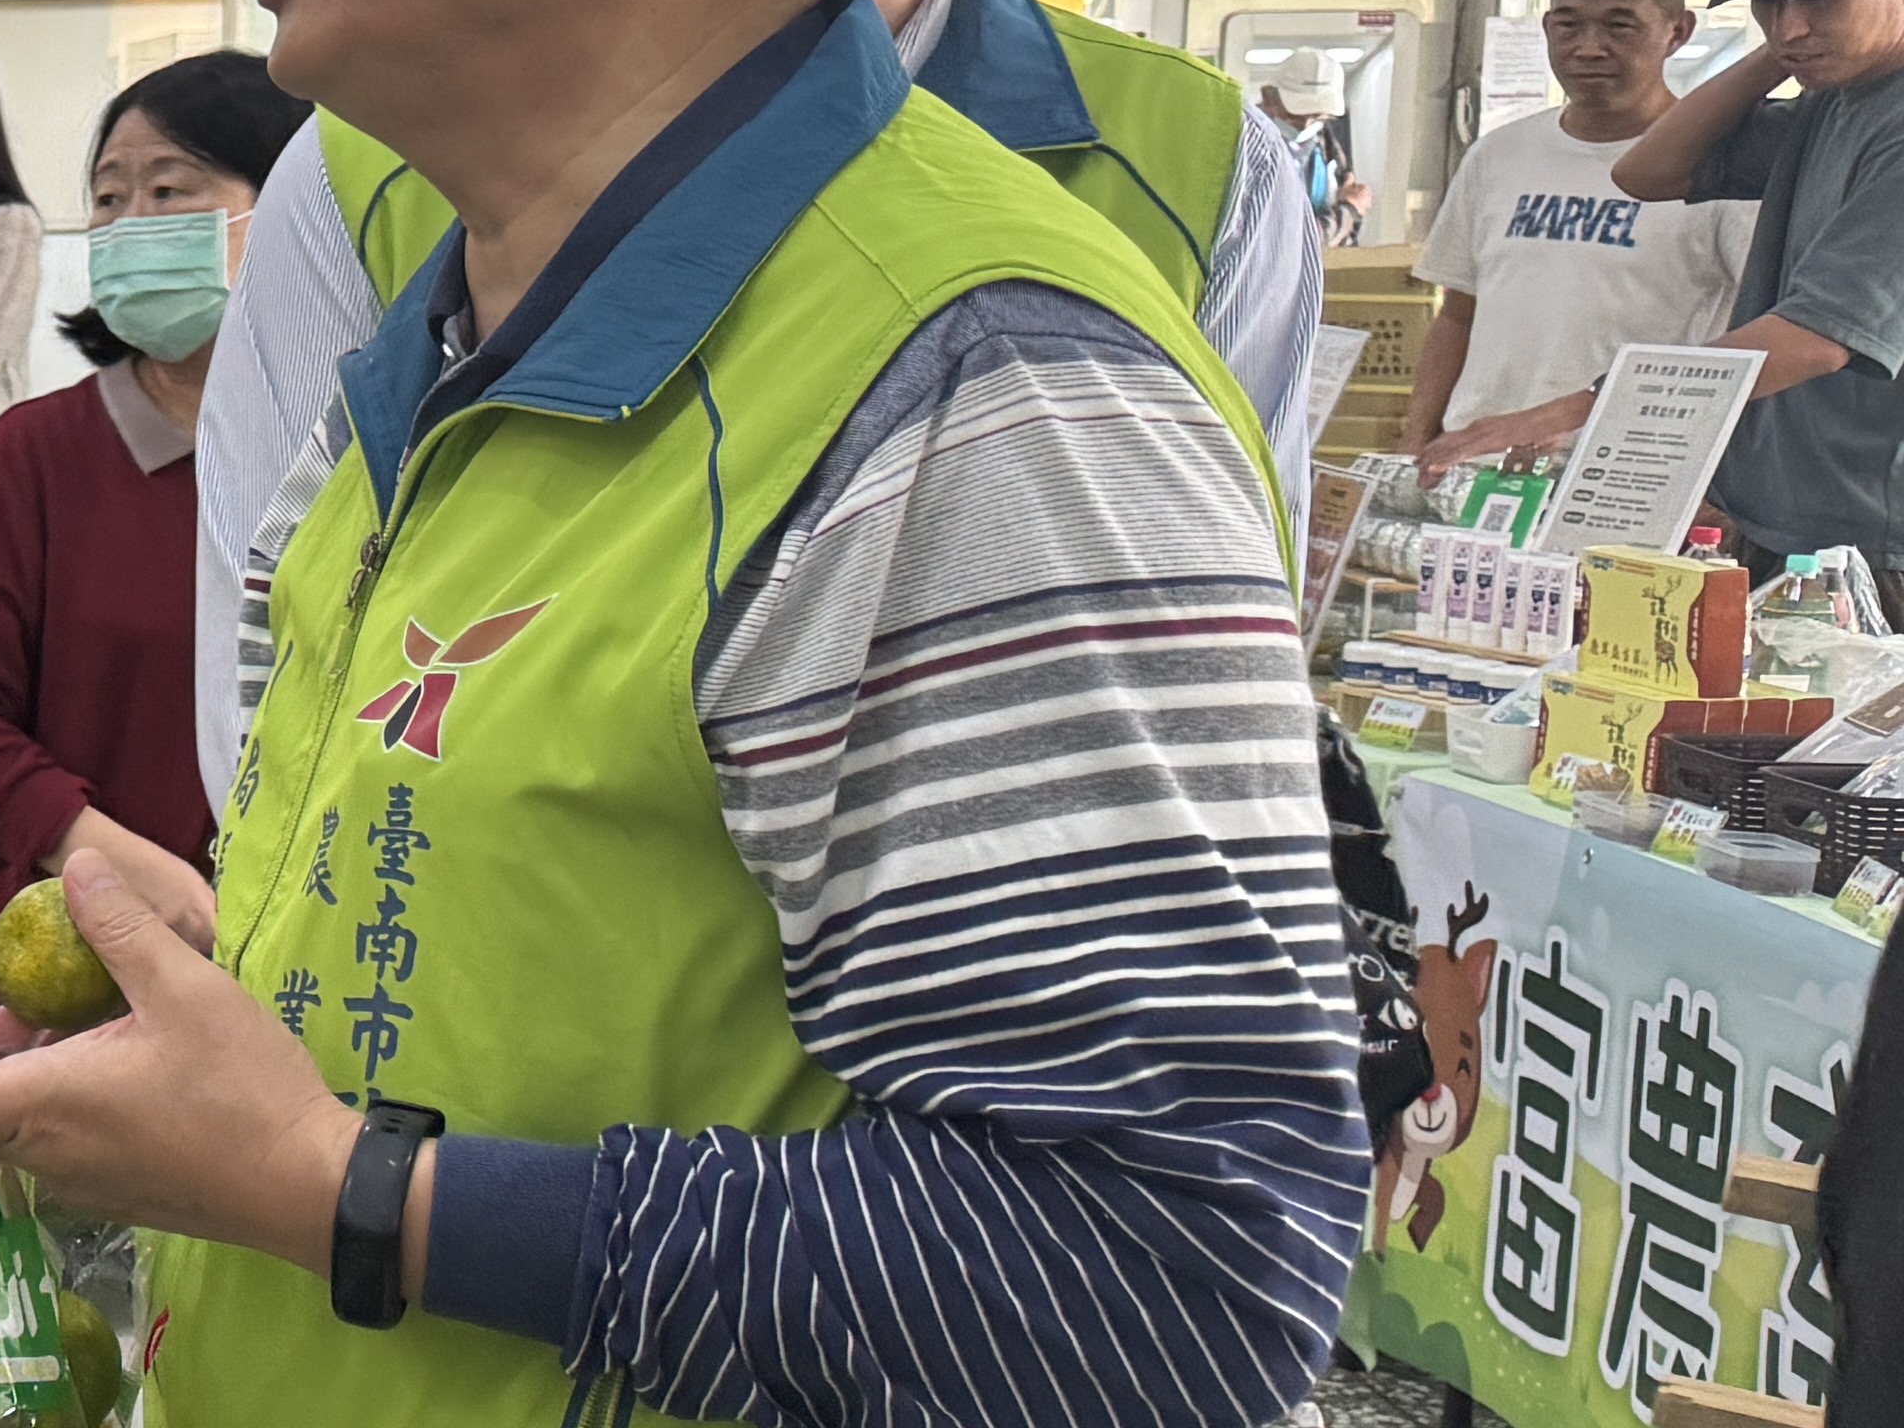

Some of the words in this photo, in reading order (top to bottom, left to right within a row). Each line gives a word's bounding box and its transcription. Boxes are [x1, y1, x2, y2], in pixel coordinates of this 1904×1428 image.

[1505, 192, 1641, 248] MARVEL
[333, 782, 432, 1108] 臺南市
